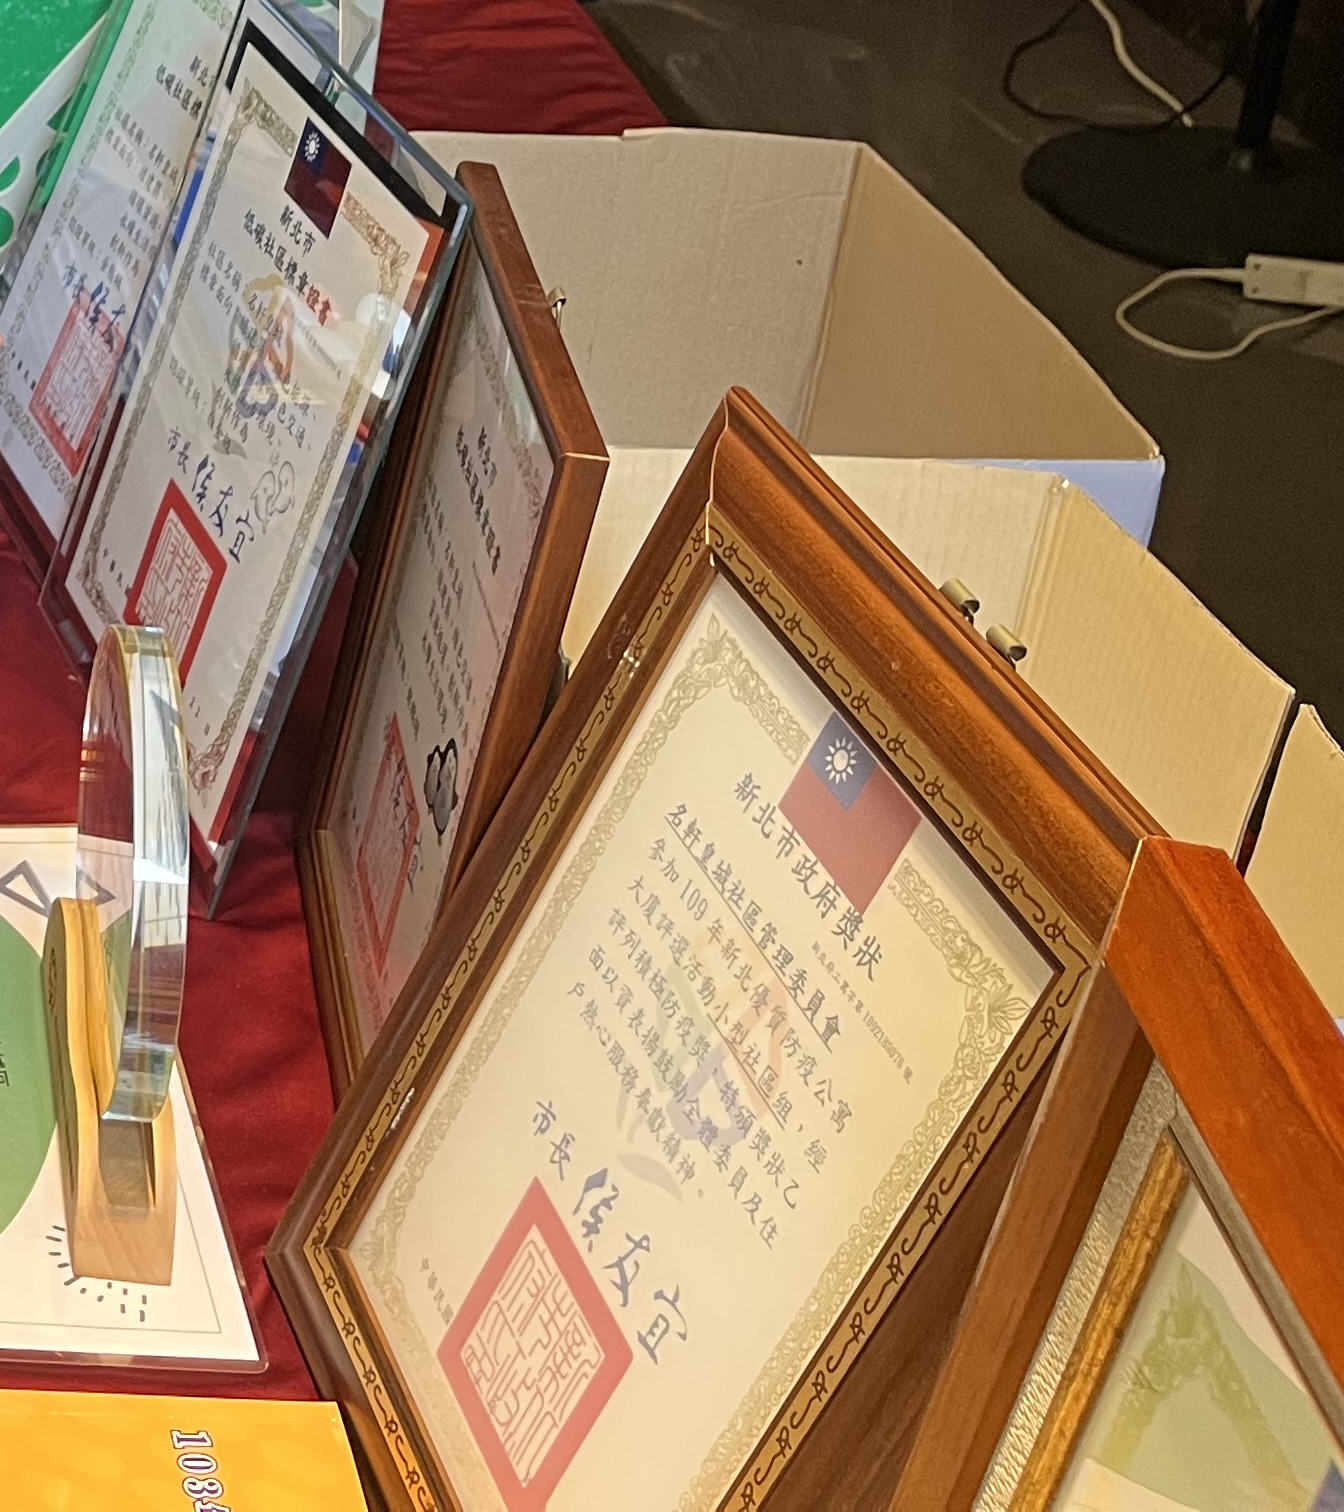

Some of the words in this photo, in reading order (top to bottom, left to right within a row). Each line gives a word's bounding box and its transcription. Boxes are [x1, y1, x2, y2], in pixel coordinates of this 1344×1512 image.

[280, 205, 315, 255] 新北市
[167, 428, 191, 474] 市長
[666, 803, 843, 1044] 名軒皇城社區管理委員會
[733, 772, 883, 981] 新北市政府獎狀
[648, 837, 680, 885] 參加
[679, 879, 710, 922] 109
[706, 918, 853, 1134] 年新北優質防疫公寓
[532, 1100, 575, 1181] 市長
